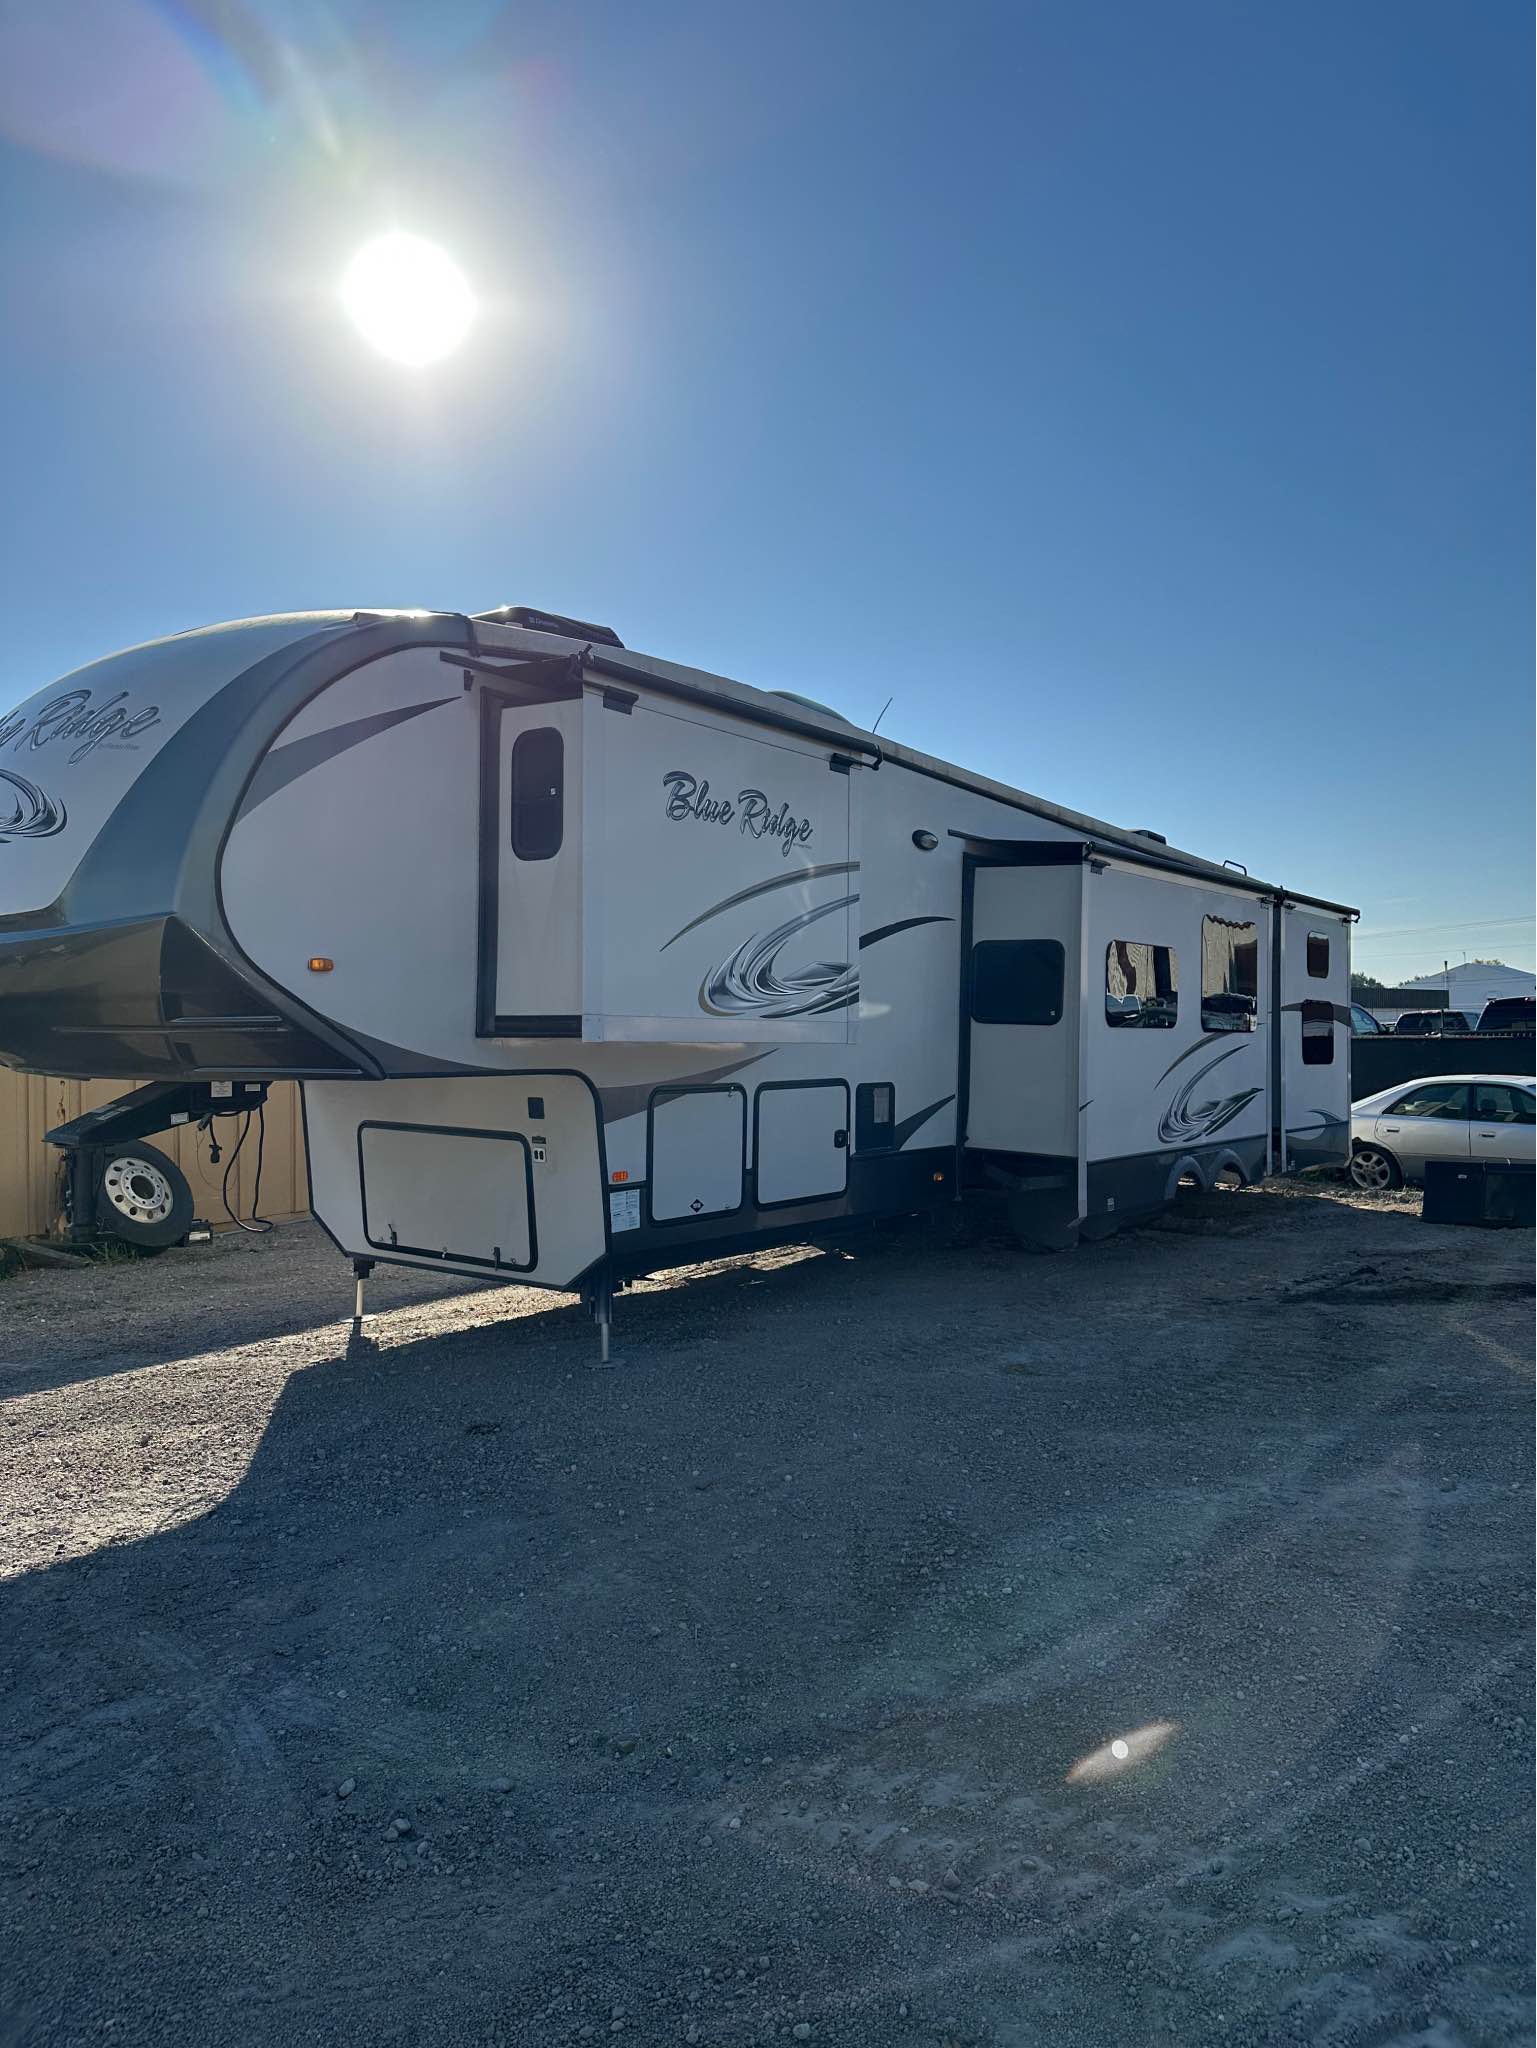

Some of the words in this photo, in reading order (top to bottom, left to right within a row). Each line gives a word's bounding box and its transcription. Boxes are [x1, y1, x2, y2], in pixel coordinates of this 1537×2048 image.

[15, 689, 161, 765] Ridge
[663, 770, 735, 825] Blue
[738, 789, 814, 857] Ridge
